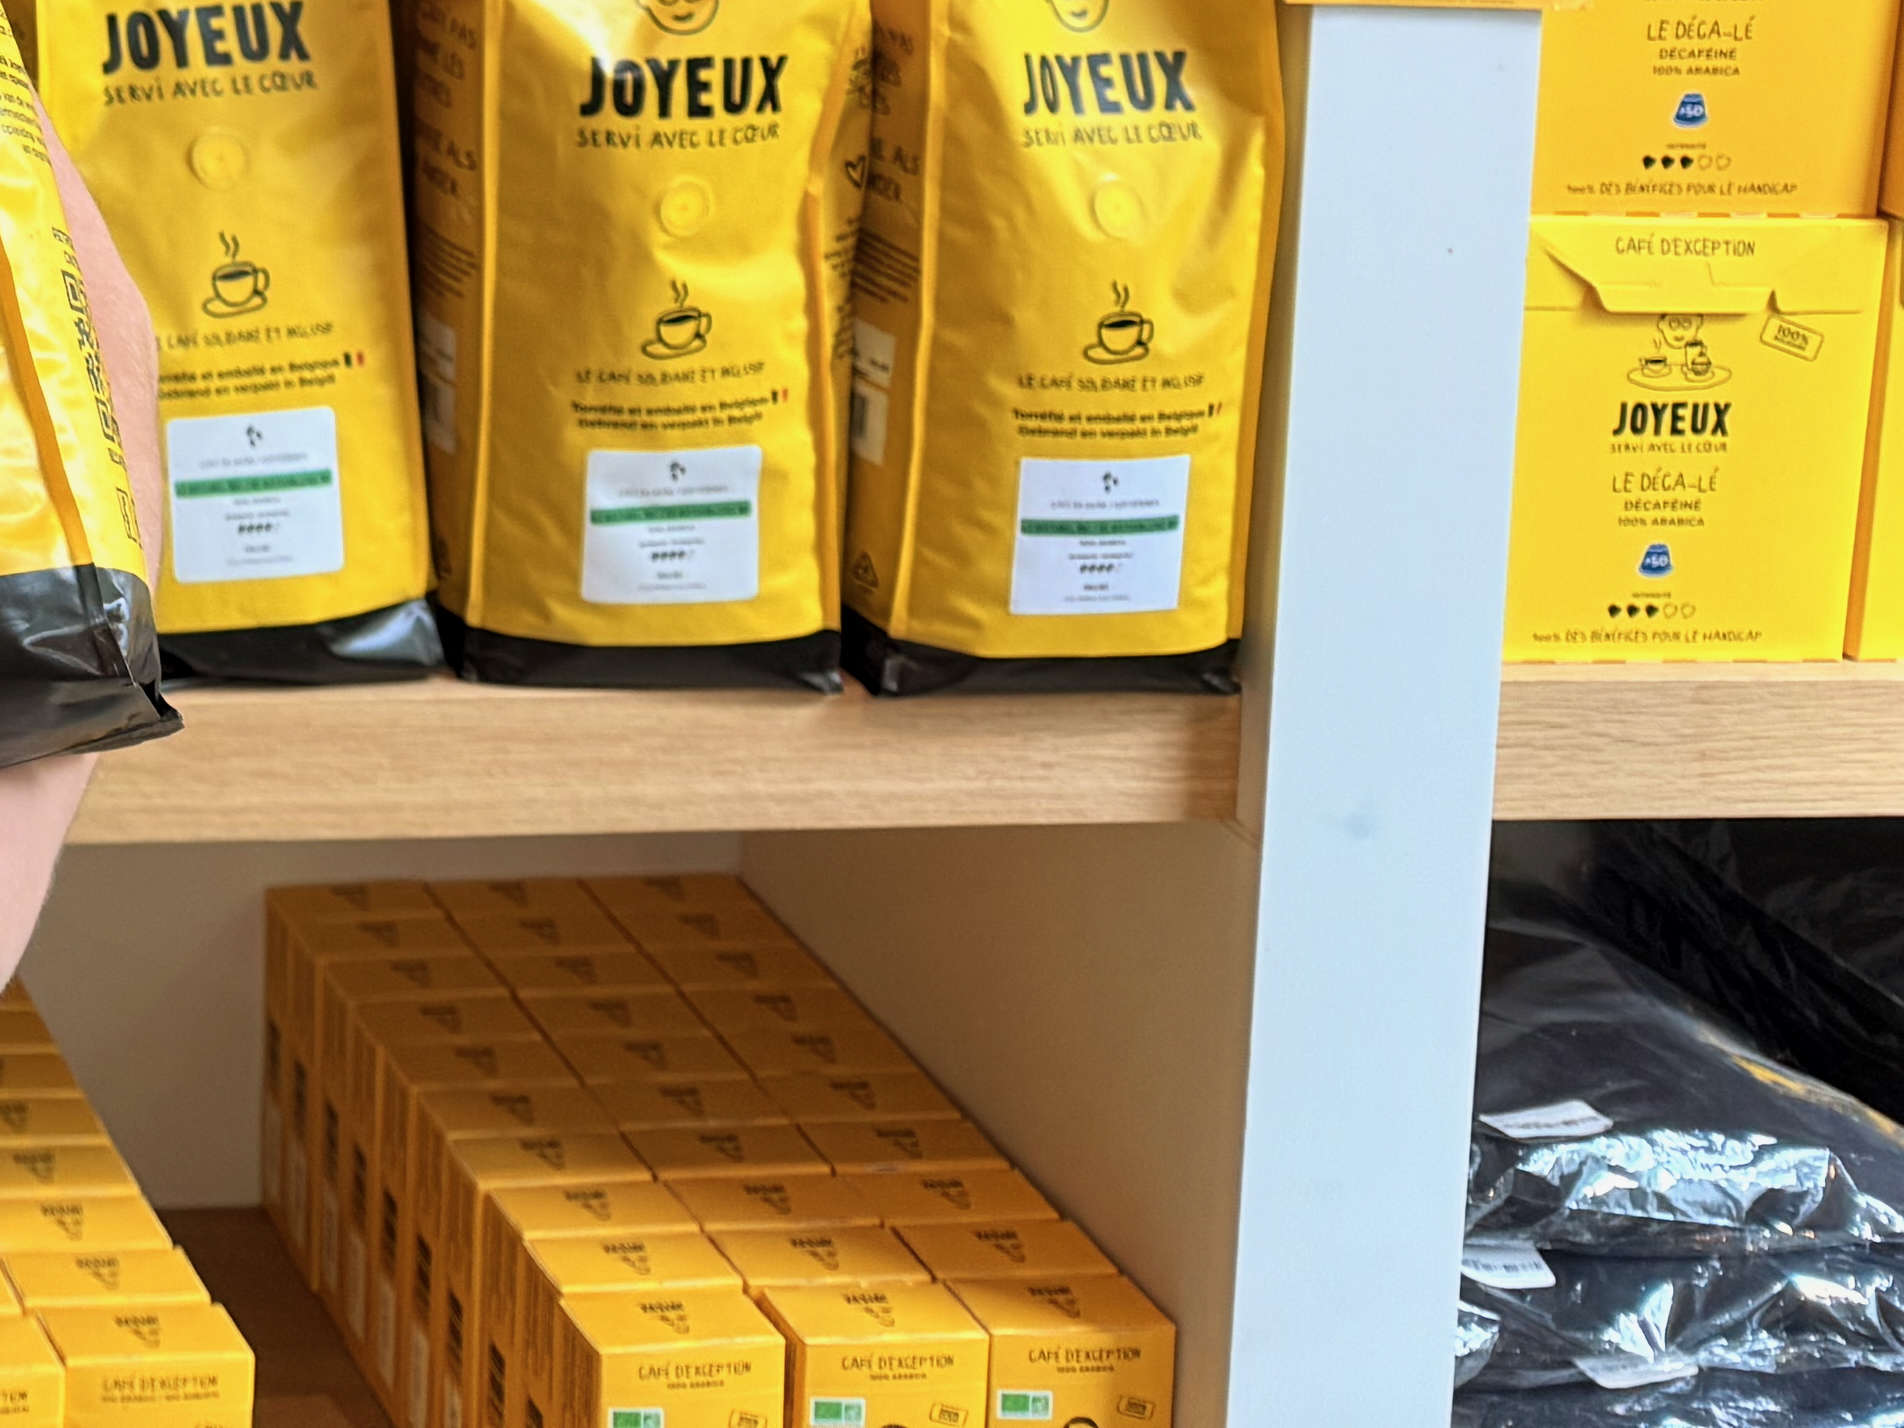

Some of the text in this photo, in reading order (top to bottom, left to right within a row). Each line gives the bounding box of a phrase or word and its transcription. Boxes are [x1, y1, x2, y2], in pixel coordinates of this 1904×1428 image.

[102, 0, 310, 75] JOYEUX
[1647, 15, 1755, 41] LE DÉCA-LÉ
[579, 55, 788, 119] JOYEUX
[1024, 49, 1196, 116] JOYEUX
[1613, 402, 1731, 437] JOYEUX
